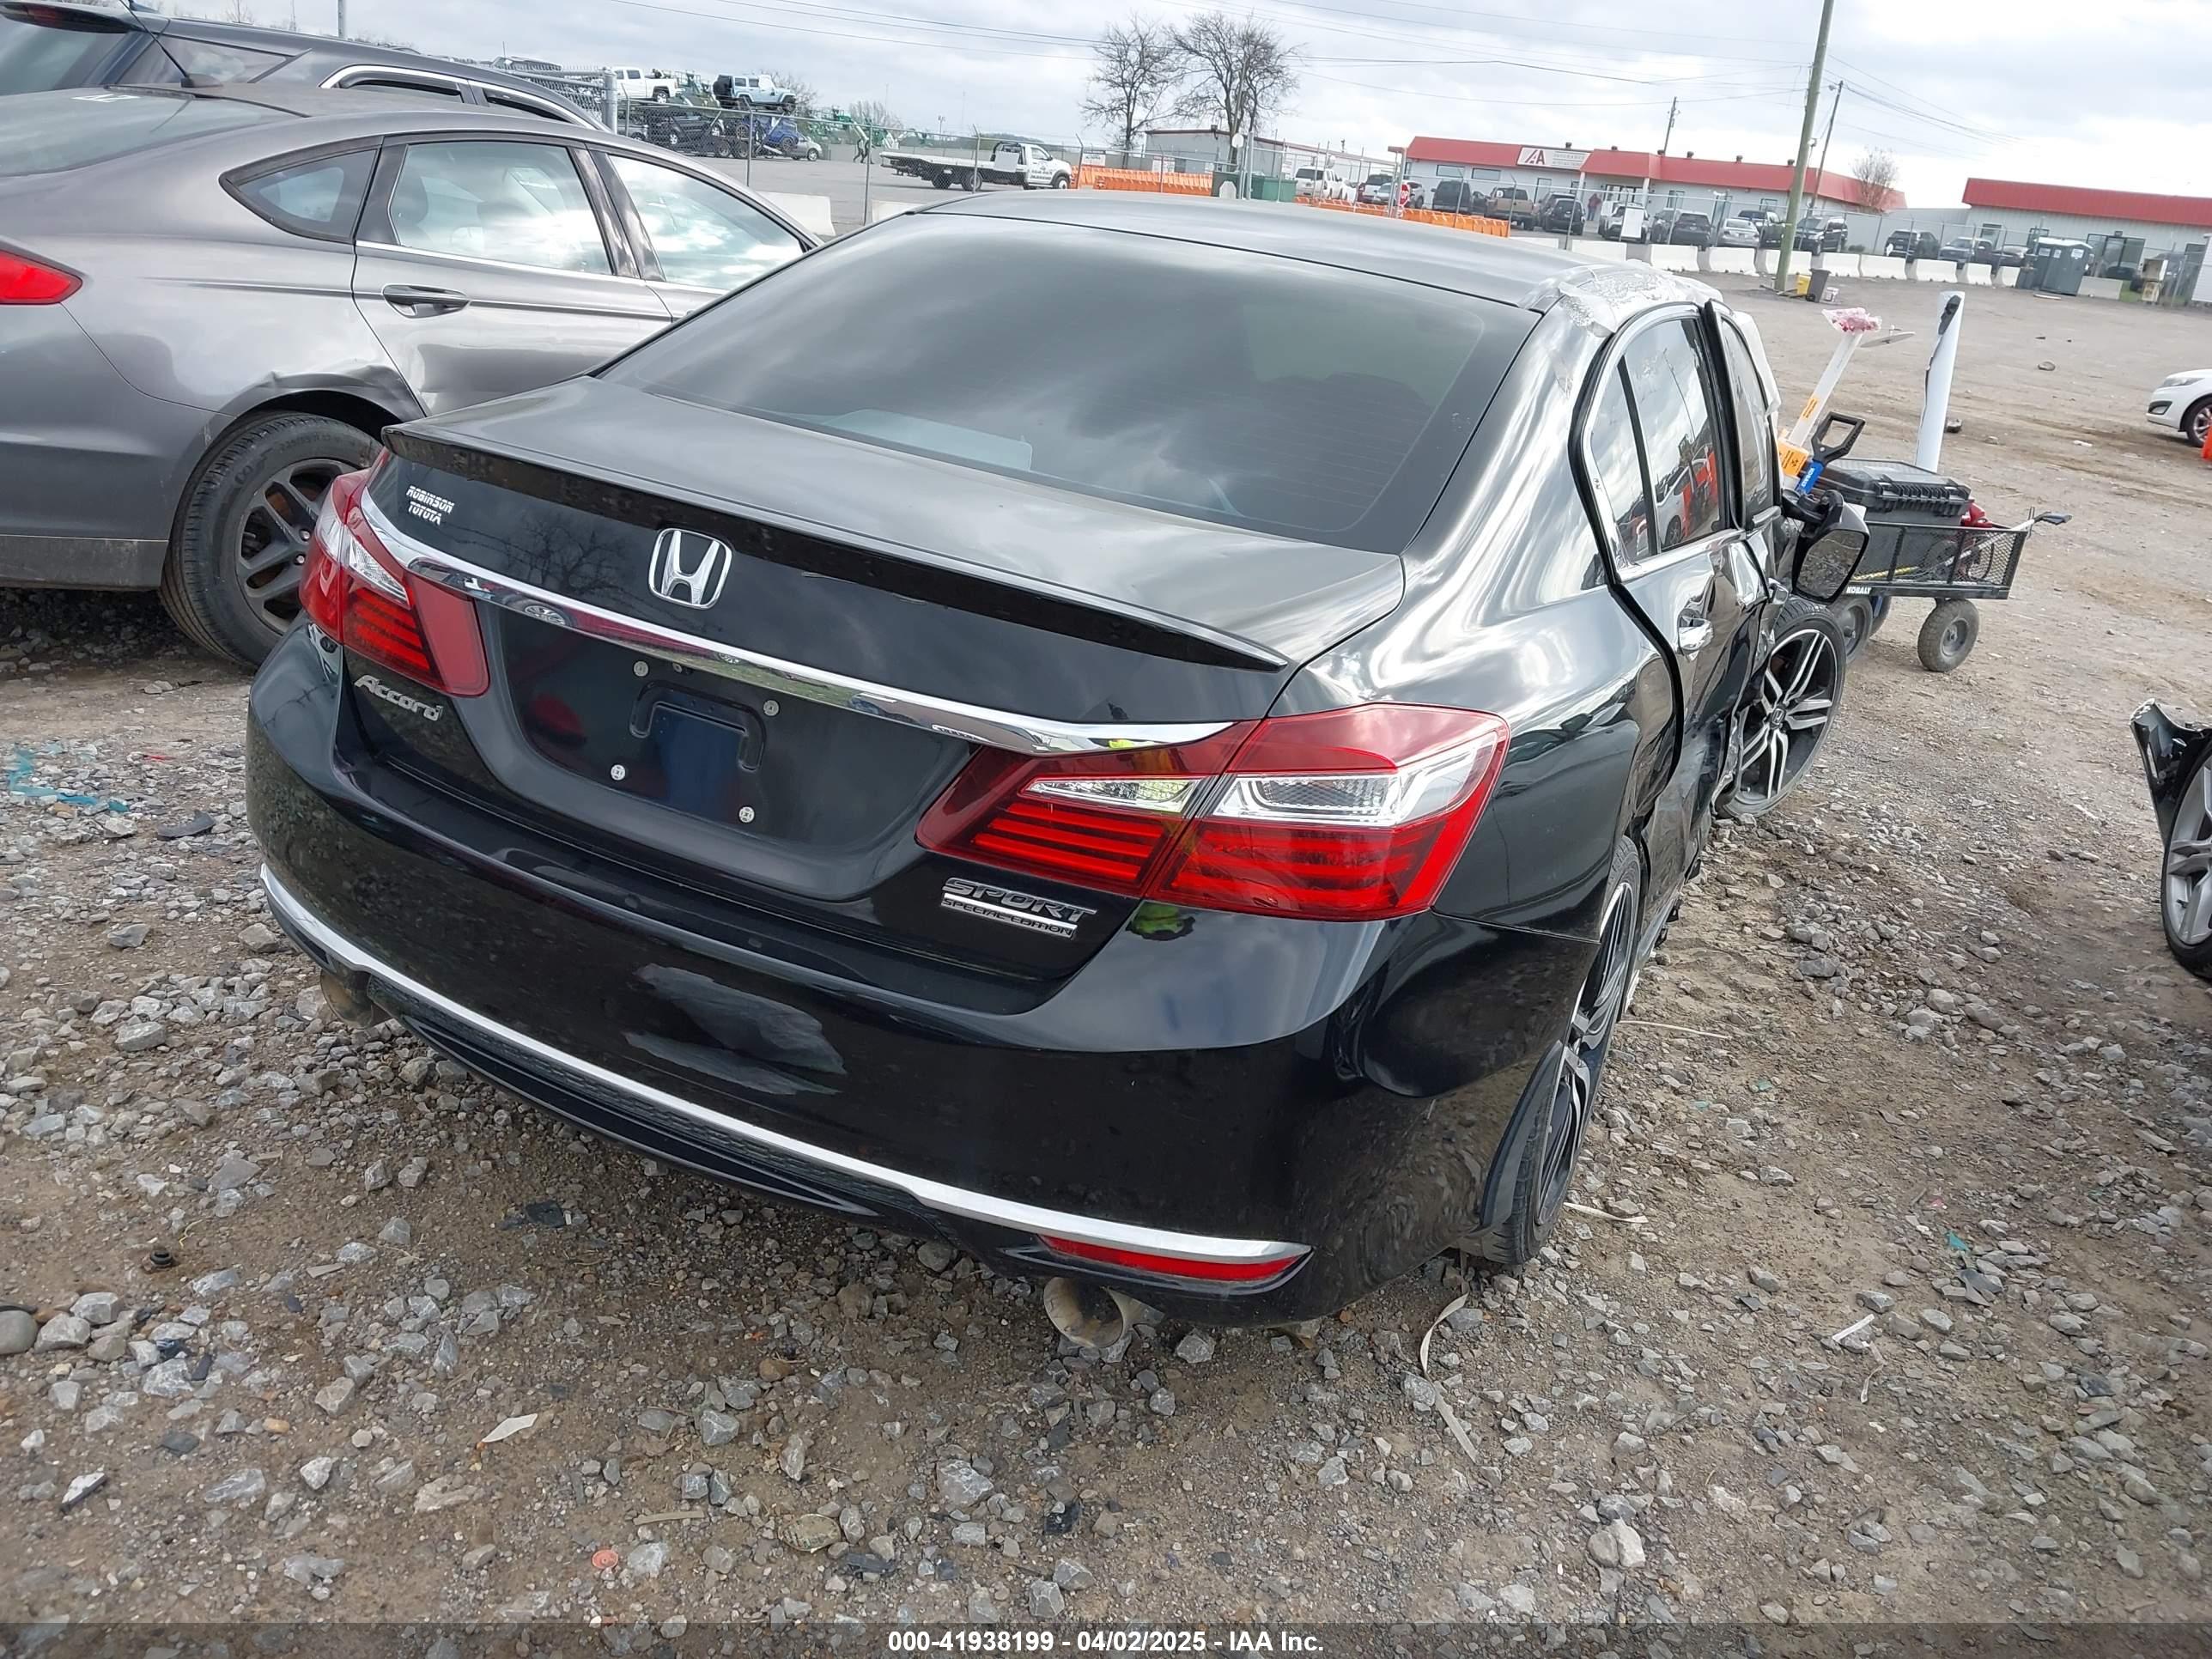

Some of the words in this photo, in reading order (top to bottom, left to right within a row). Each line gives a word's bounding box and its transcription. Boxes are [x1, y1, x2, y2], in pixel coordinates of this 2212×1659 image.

[406, 484, 455, 514] ROBINSON
[354, 674, 444, 721] Accord
[941, 877, 1098, 922] SPORT
[942, 896, 1007, 921] SPECIAL
[1009, 914, 1073, 938] EDITION
